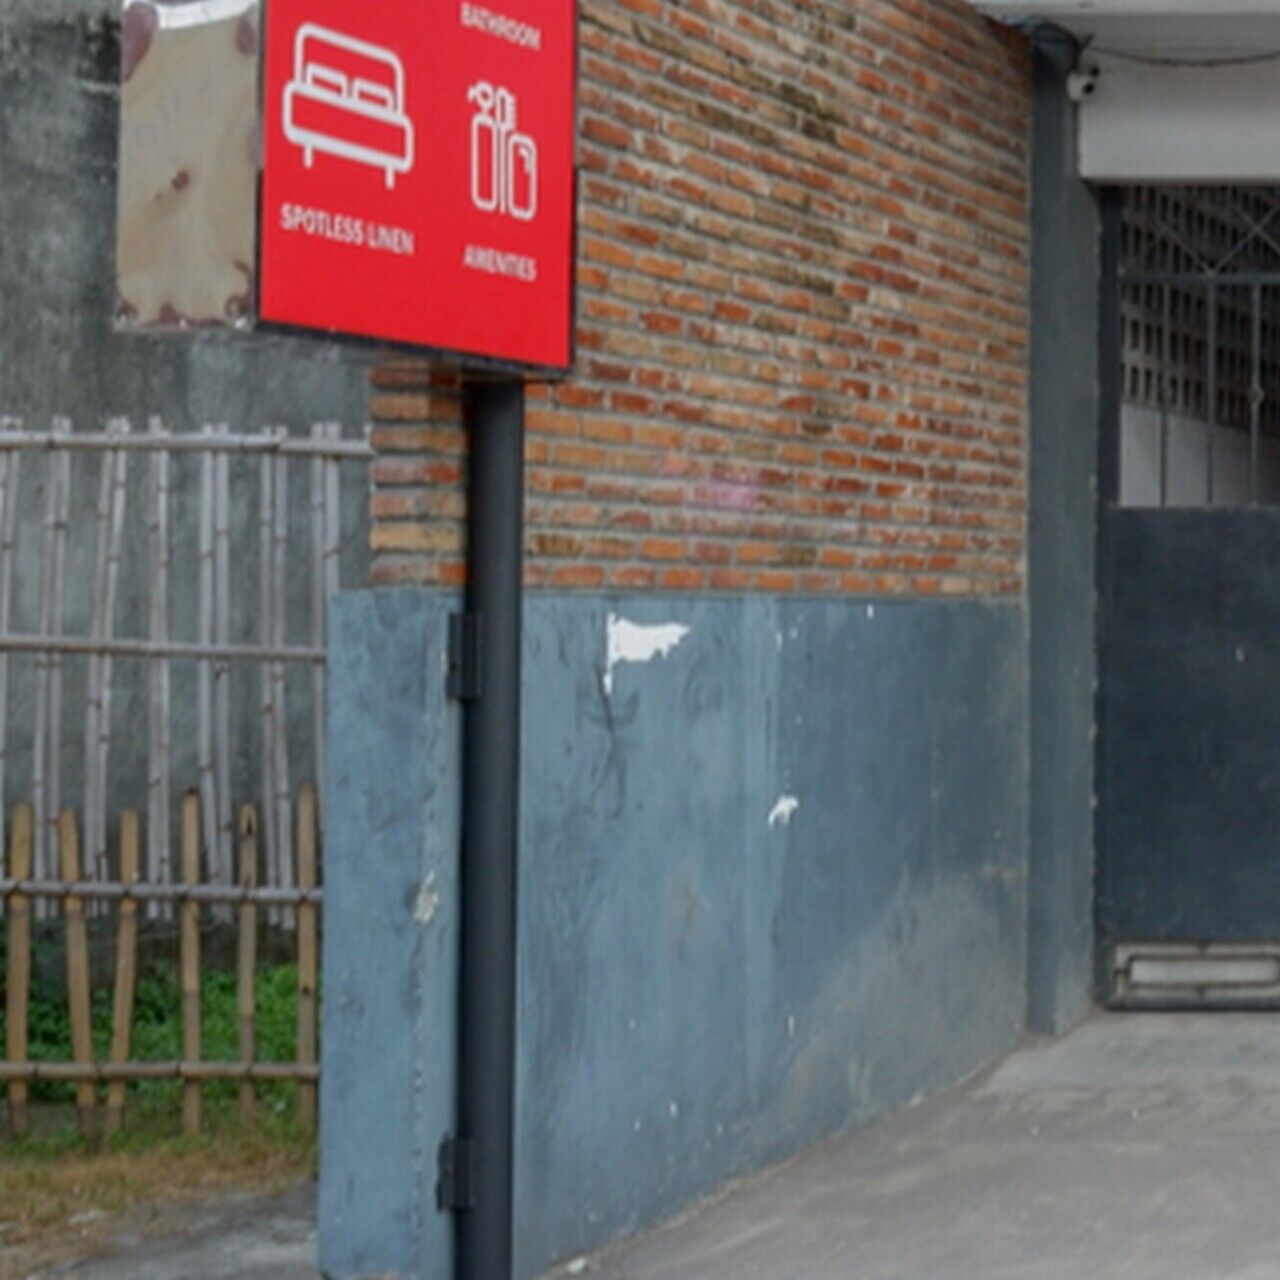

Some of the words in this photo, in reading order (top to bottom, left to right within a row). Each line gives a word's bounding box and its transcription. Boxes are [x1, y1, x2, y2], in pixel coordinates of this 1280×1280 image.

[460, 0, 543, 51] BATHROOM
[279, 202, 365, 246] SPOTLESS
[366, 223, 415, 256] LINEN
